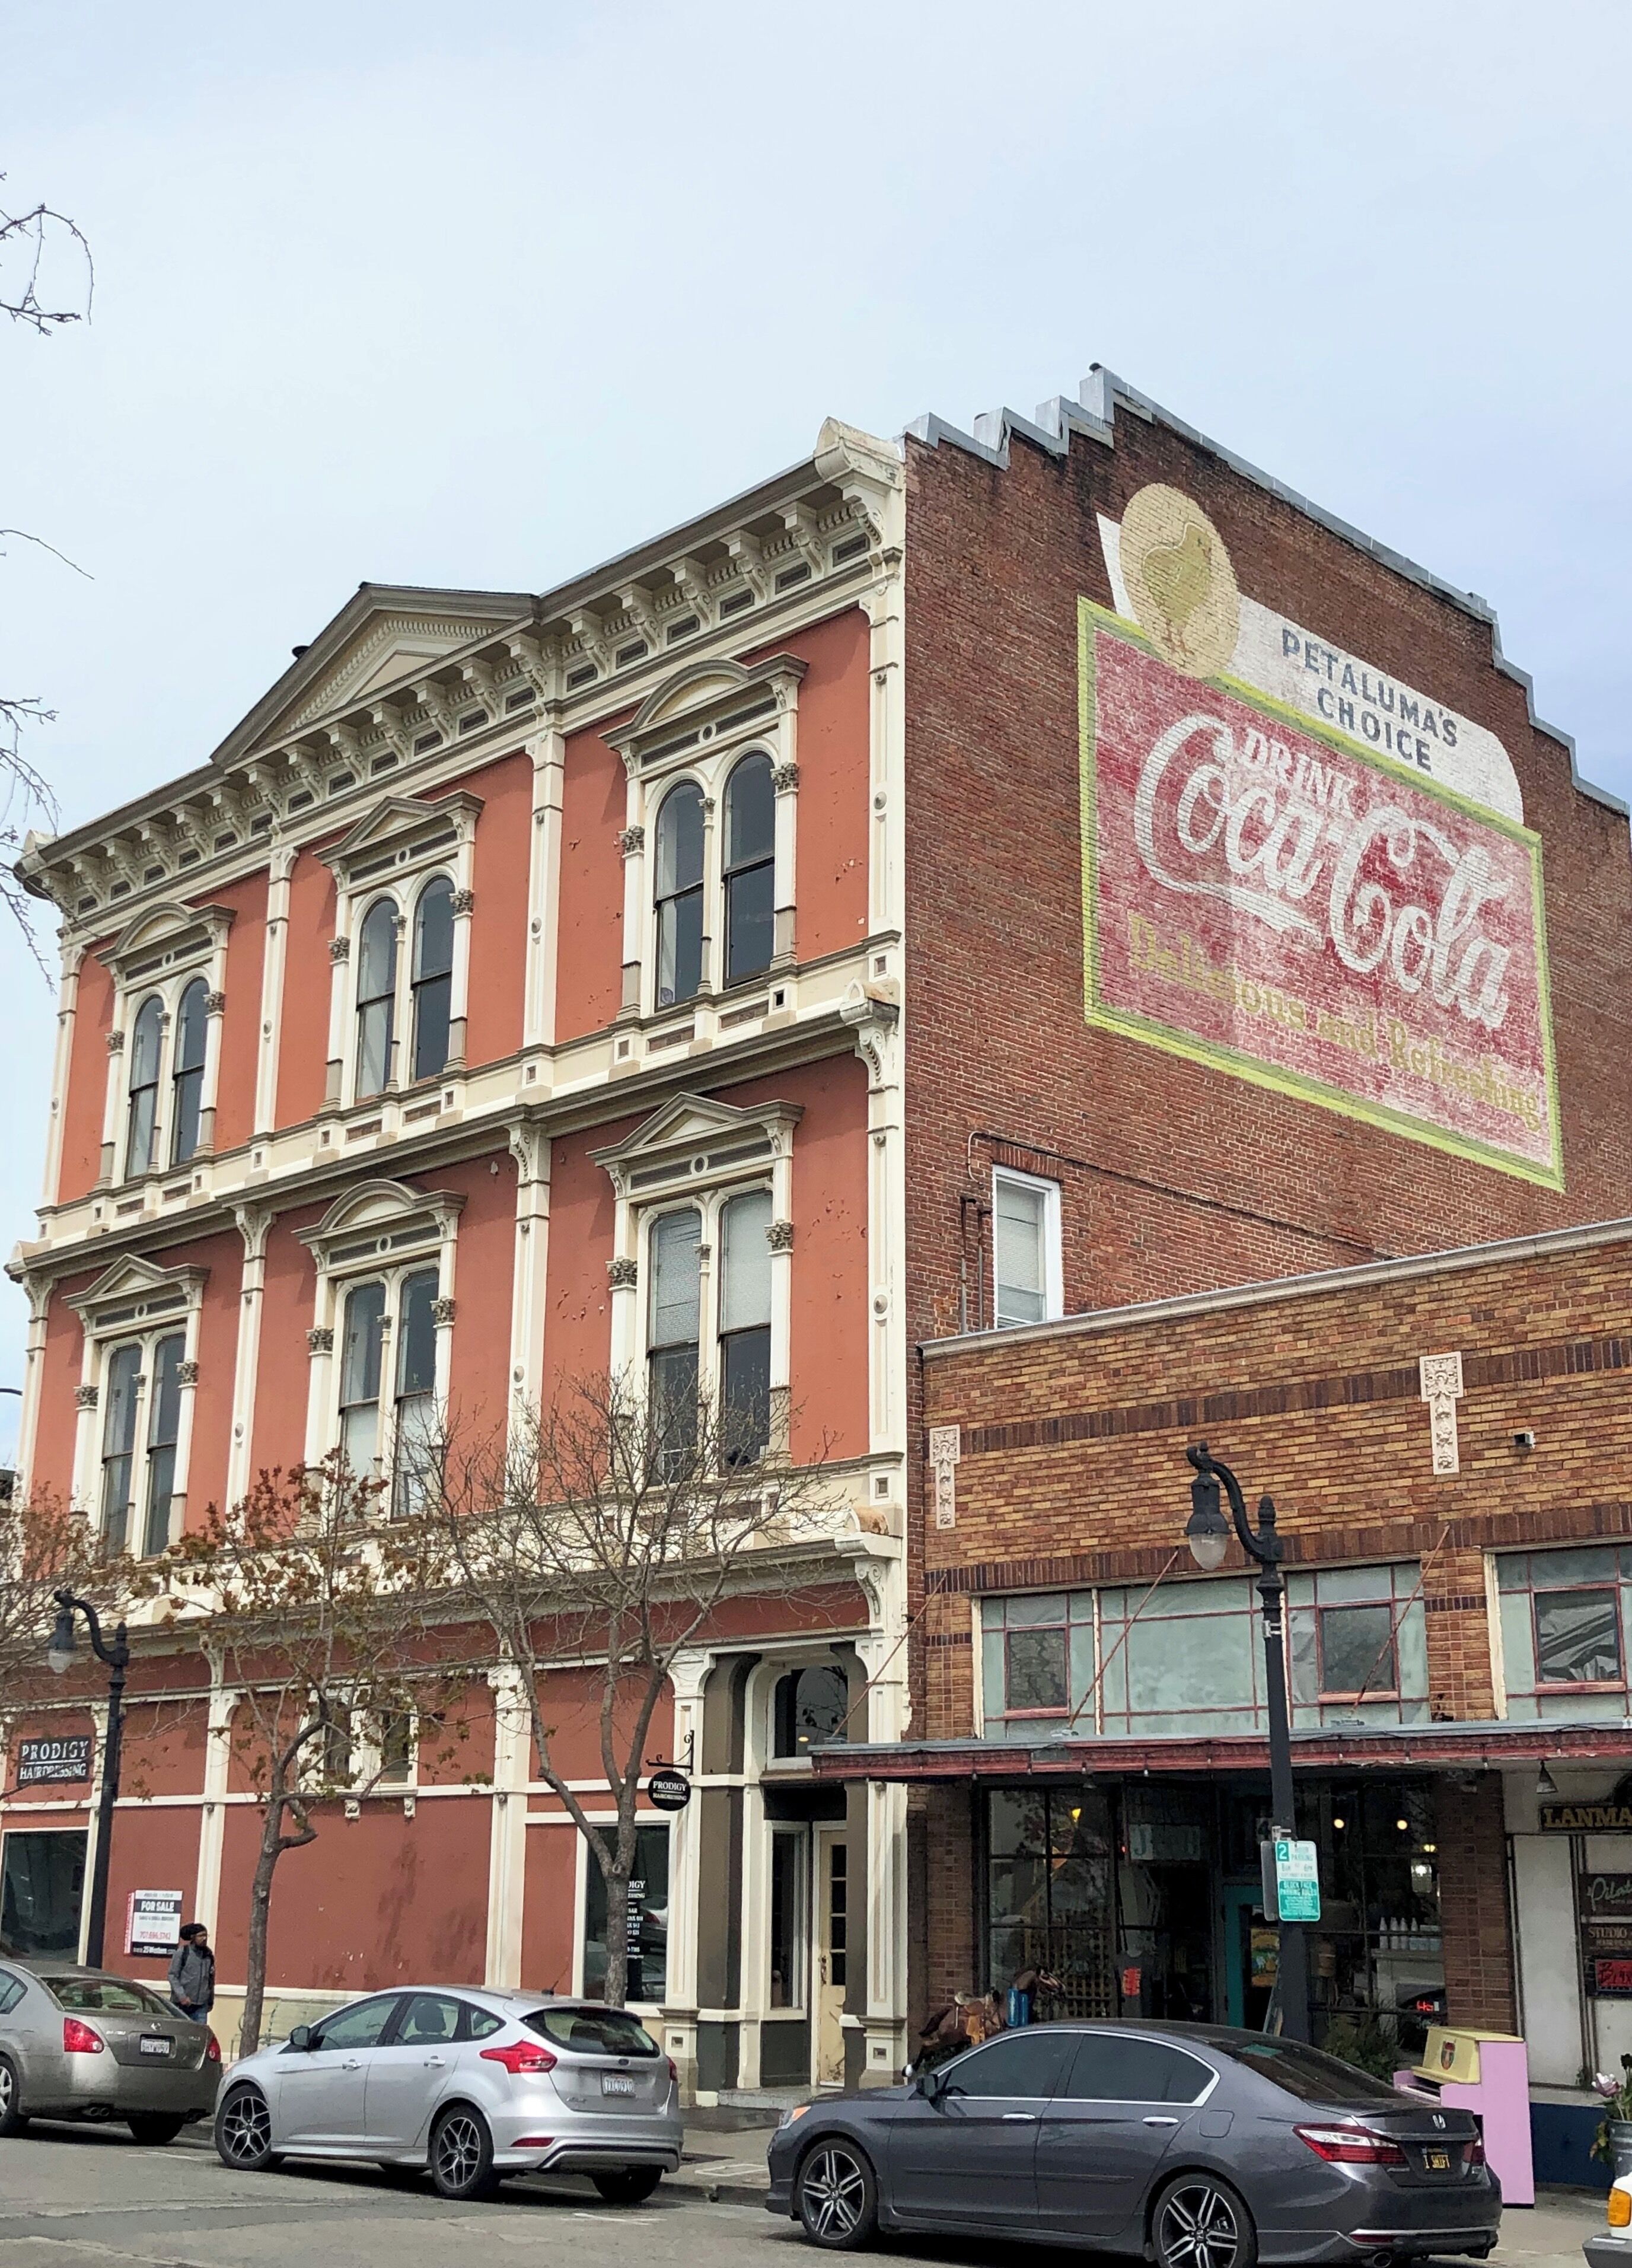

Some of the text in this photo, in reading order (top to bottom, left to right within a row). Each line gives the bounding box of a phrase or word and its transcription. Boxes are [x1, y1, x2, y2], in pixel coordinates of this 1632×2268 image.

[1282, 628, 1458, 748] PETALUMA'S
[1317, 688, 1433, 772] CHOICE
[1237, 727, 1357, 816] DRINK
[1318, 1009, 1379, 1059] and
[1387, 1017, 1541, 1132] Refreshing
[21, 1741, 89, 1760] PRODIGY
[653, 1780, 687, 1791] PRODIGY
[1279, 1843, 1287, 1859] 2
[141, 1900, 174, 1912] FOR SALE
[1588, 1927, 1628, 1939] STUDIO
